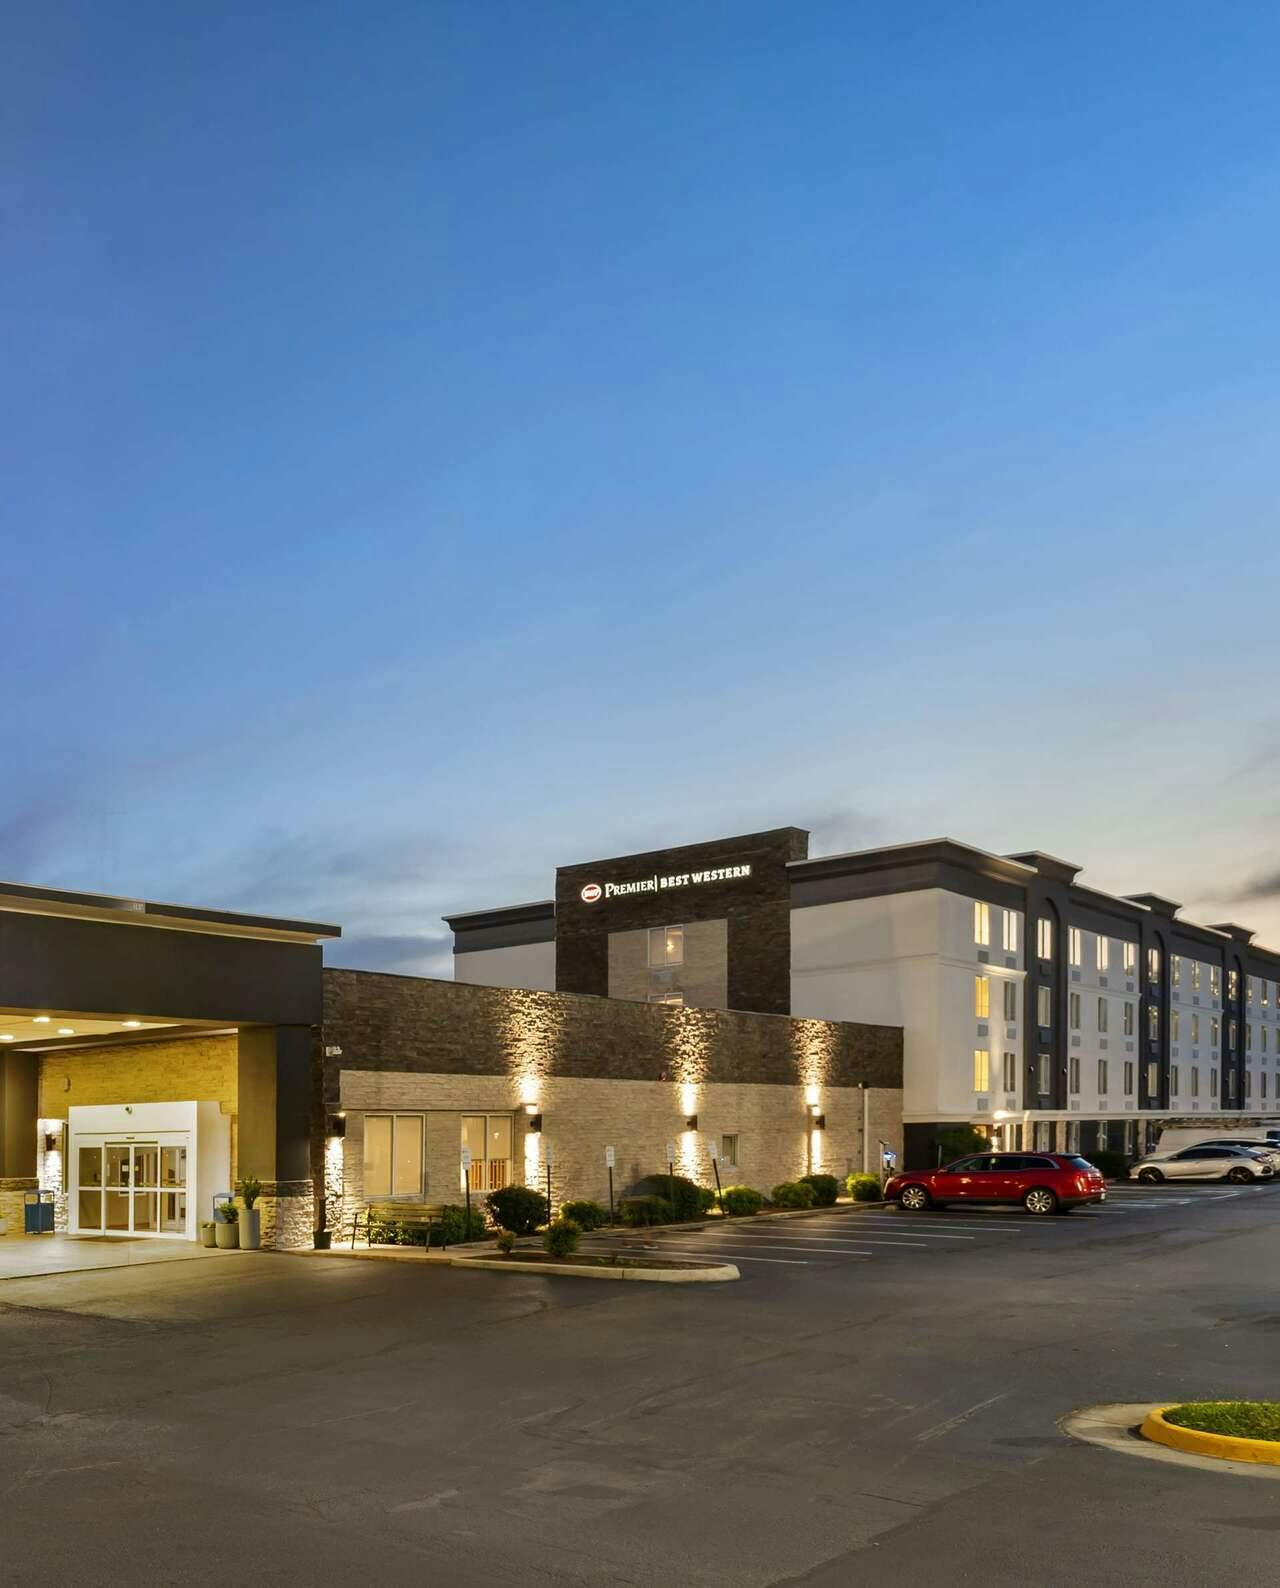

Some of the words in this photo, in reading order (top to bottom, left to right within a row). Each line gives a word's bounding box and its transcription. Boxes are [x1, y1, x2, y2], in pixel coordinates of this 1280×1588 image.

[604, 879, 655, 898] PREMIER
[660, 874, 690, 889] BEST
[691, 864, 751, 884] WESTERN
